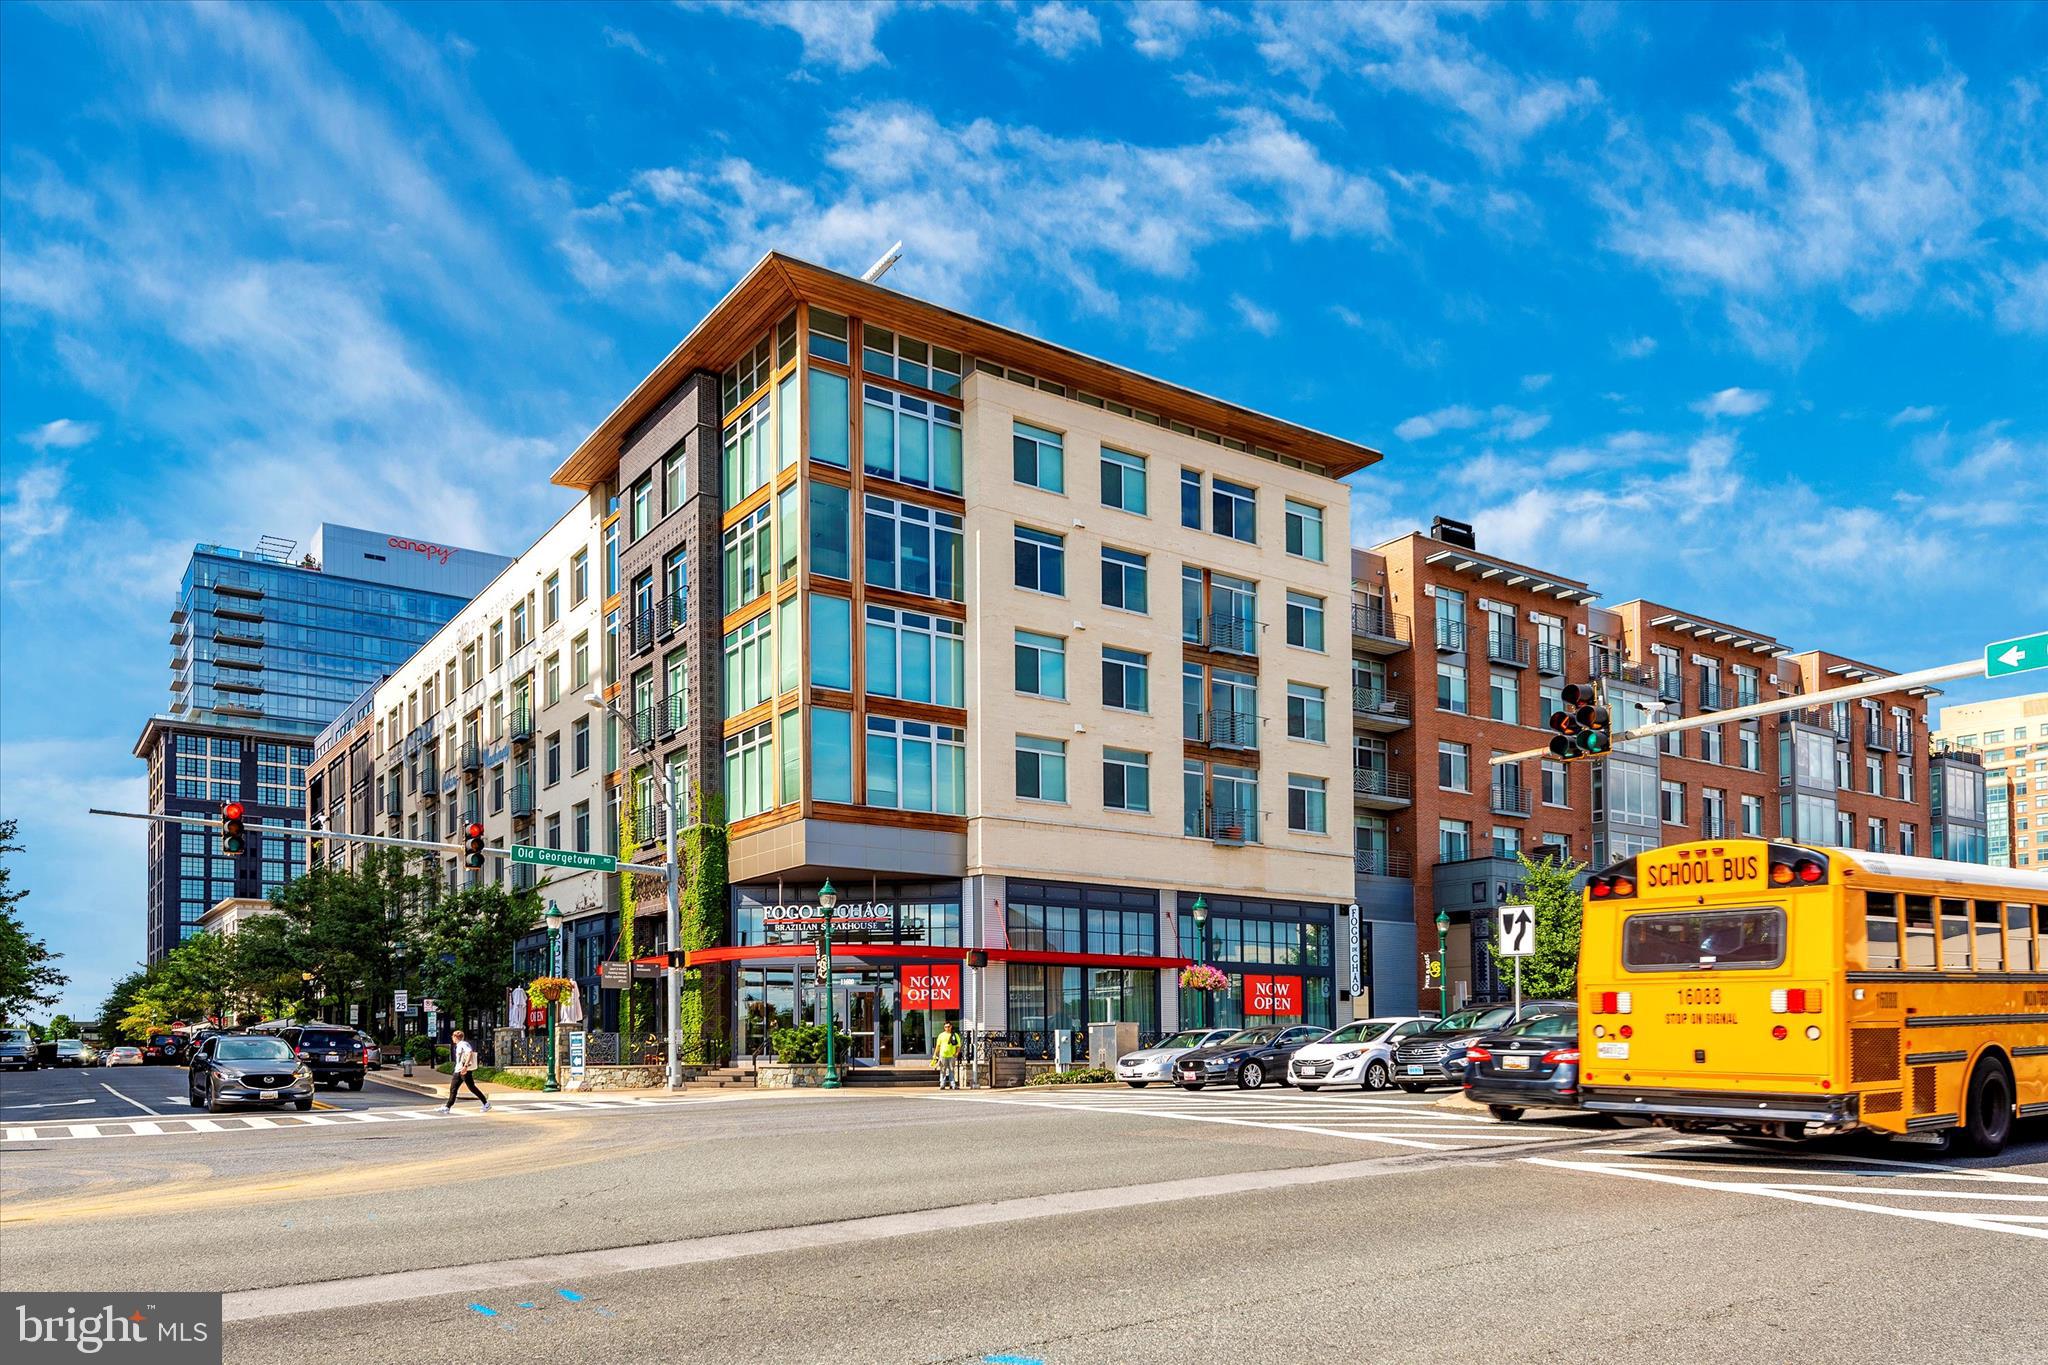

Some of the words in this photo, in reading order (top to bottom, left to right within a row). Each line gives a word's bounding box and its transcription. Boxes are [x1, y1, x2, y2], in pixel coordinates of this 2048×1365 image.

[388, 537, 459, 565] canopy
[518, 848, 534, 858] Old
[538, 850, 596, 865] Georgetown
[1648, 861, 1715, 887] SCHOOL
[1723, 856, 1758, 881] BUS
[763, 904, 813, 920] FOGO
[837, 902, 889, 919] CHÃO
[775, 923, 818, 932] BRAZILIAN
[820, 922, 878, 931] SEAKHOUSE
[1350, 908, 1359, 945] FOGO
[910, 975, 951, 988] NOW
[907, 988, 952, 1001] OPEN
[1255, 982, 1290, 996] NOW
[1253, 996, 1292, 1010] OPEN
[1677, 988, 1720, 1005] 16088
[396, 1002, 407, 1010] 25
[1665, 1013, 1687, 1024] STOP
[1691, 1013, 1703, 1024] ON
